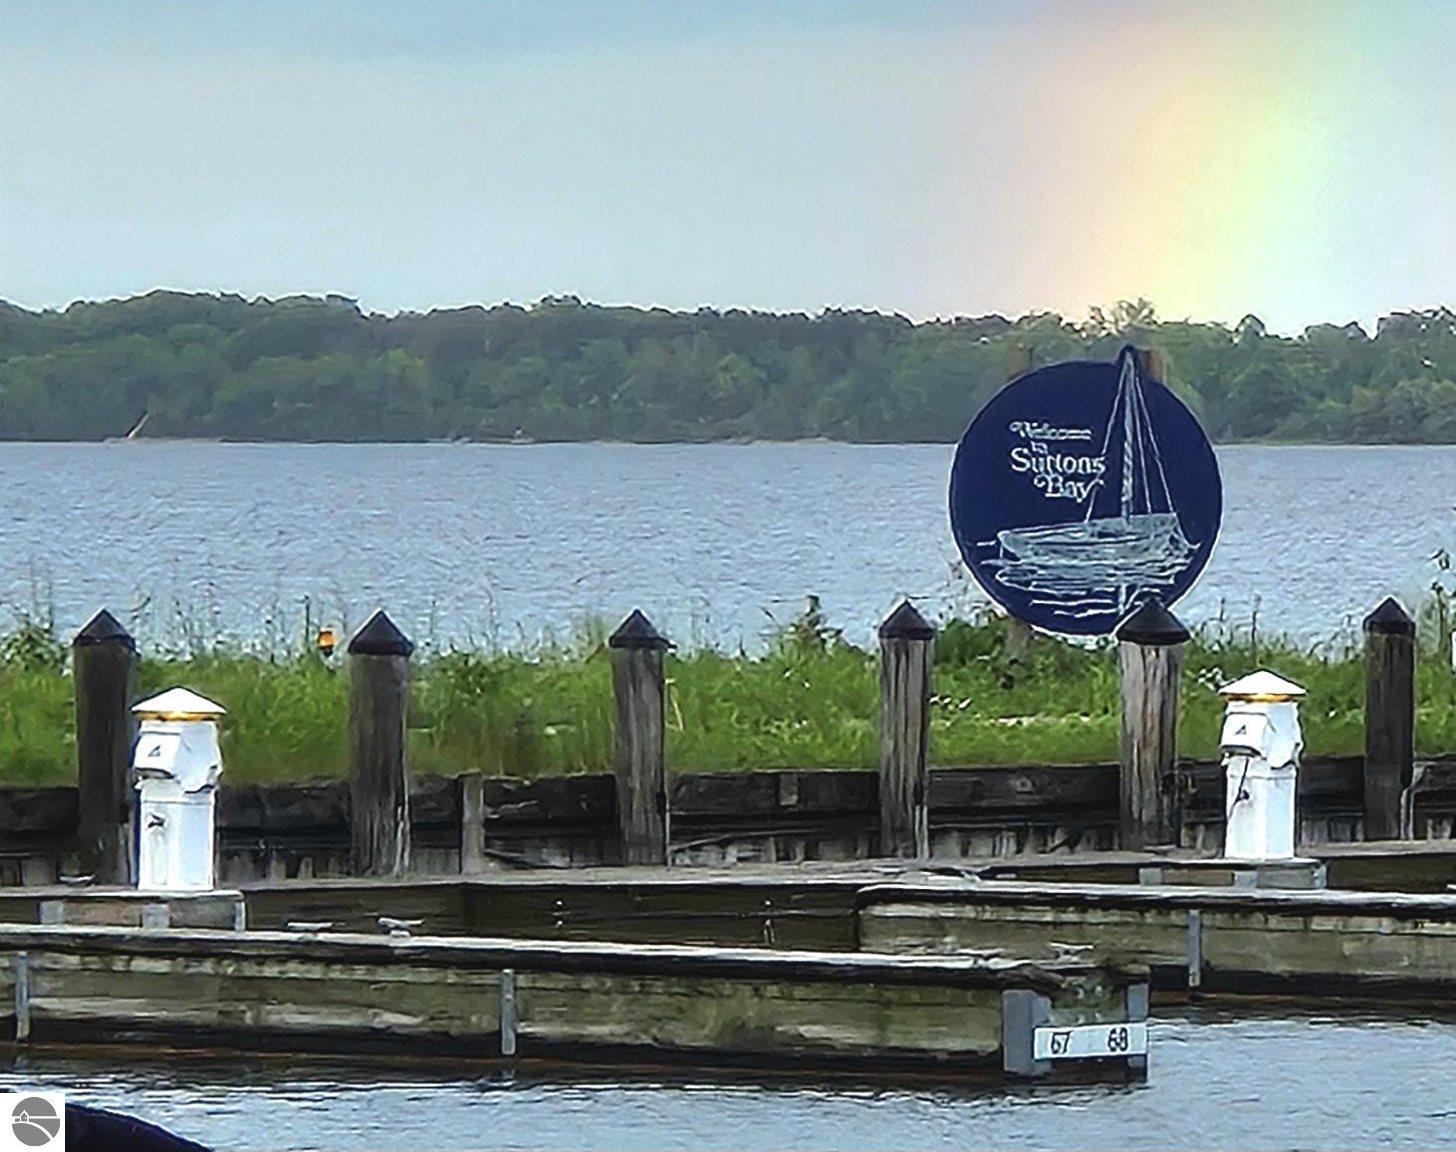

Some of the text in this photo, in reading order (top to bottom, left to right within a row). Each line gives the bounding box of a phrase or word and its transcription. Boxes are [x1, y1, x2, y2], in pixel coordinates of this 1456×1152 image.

[1011, 447, 1105, 475] Suttons
[1033, 473, 1105, 503] Bay
[1051, 1027, 1129, 1054] 67 68
